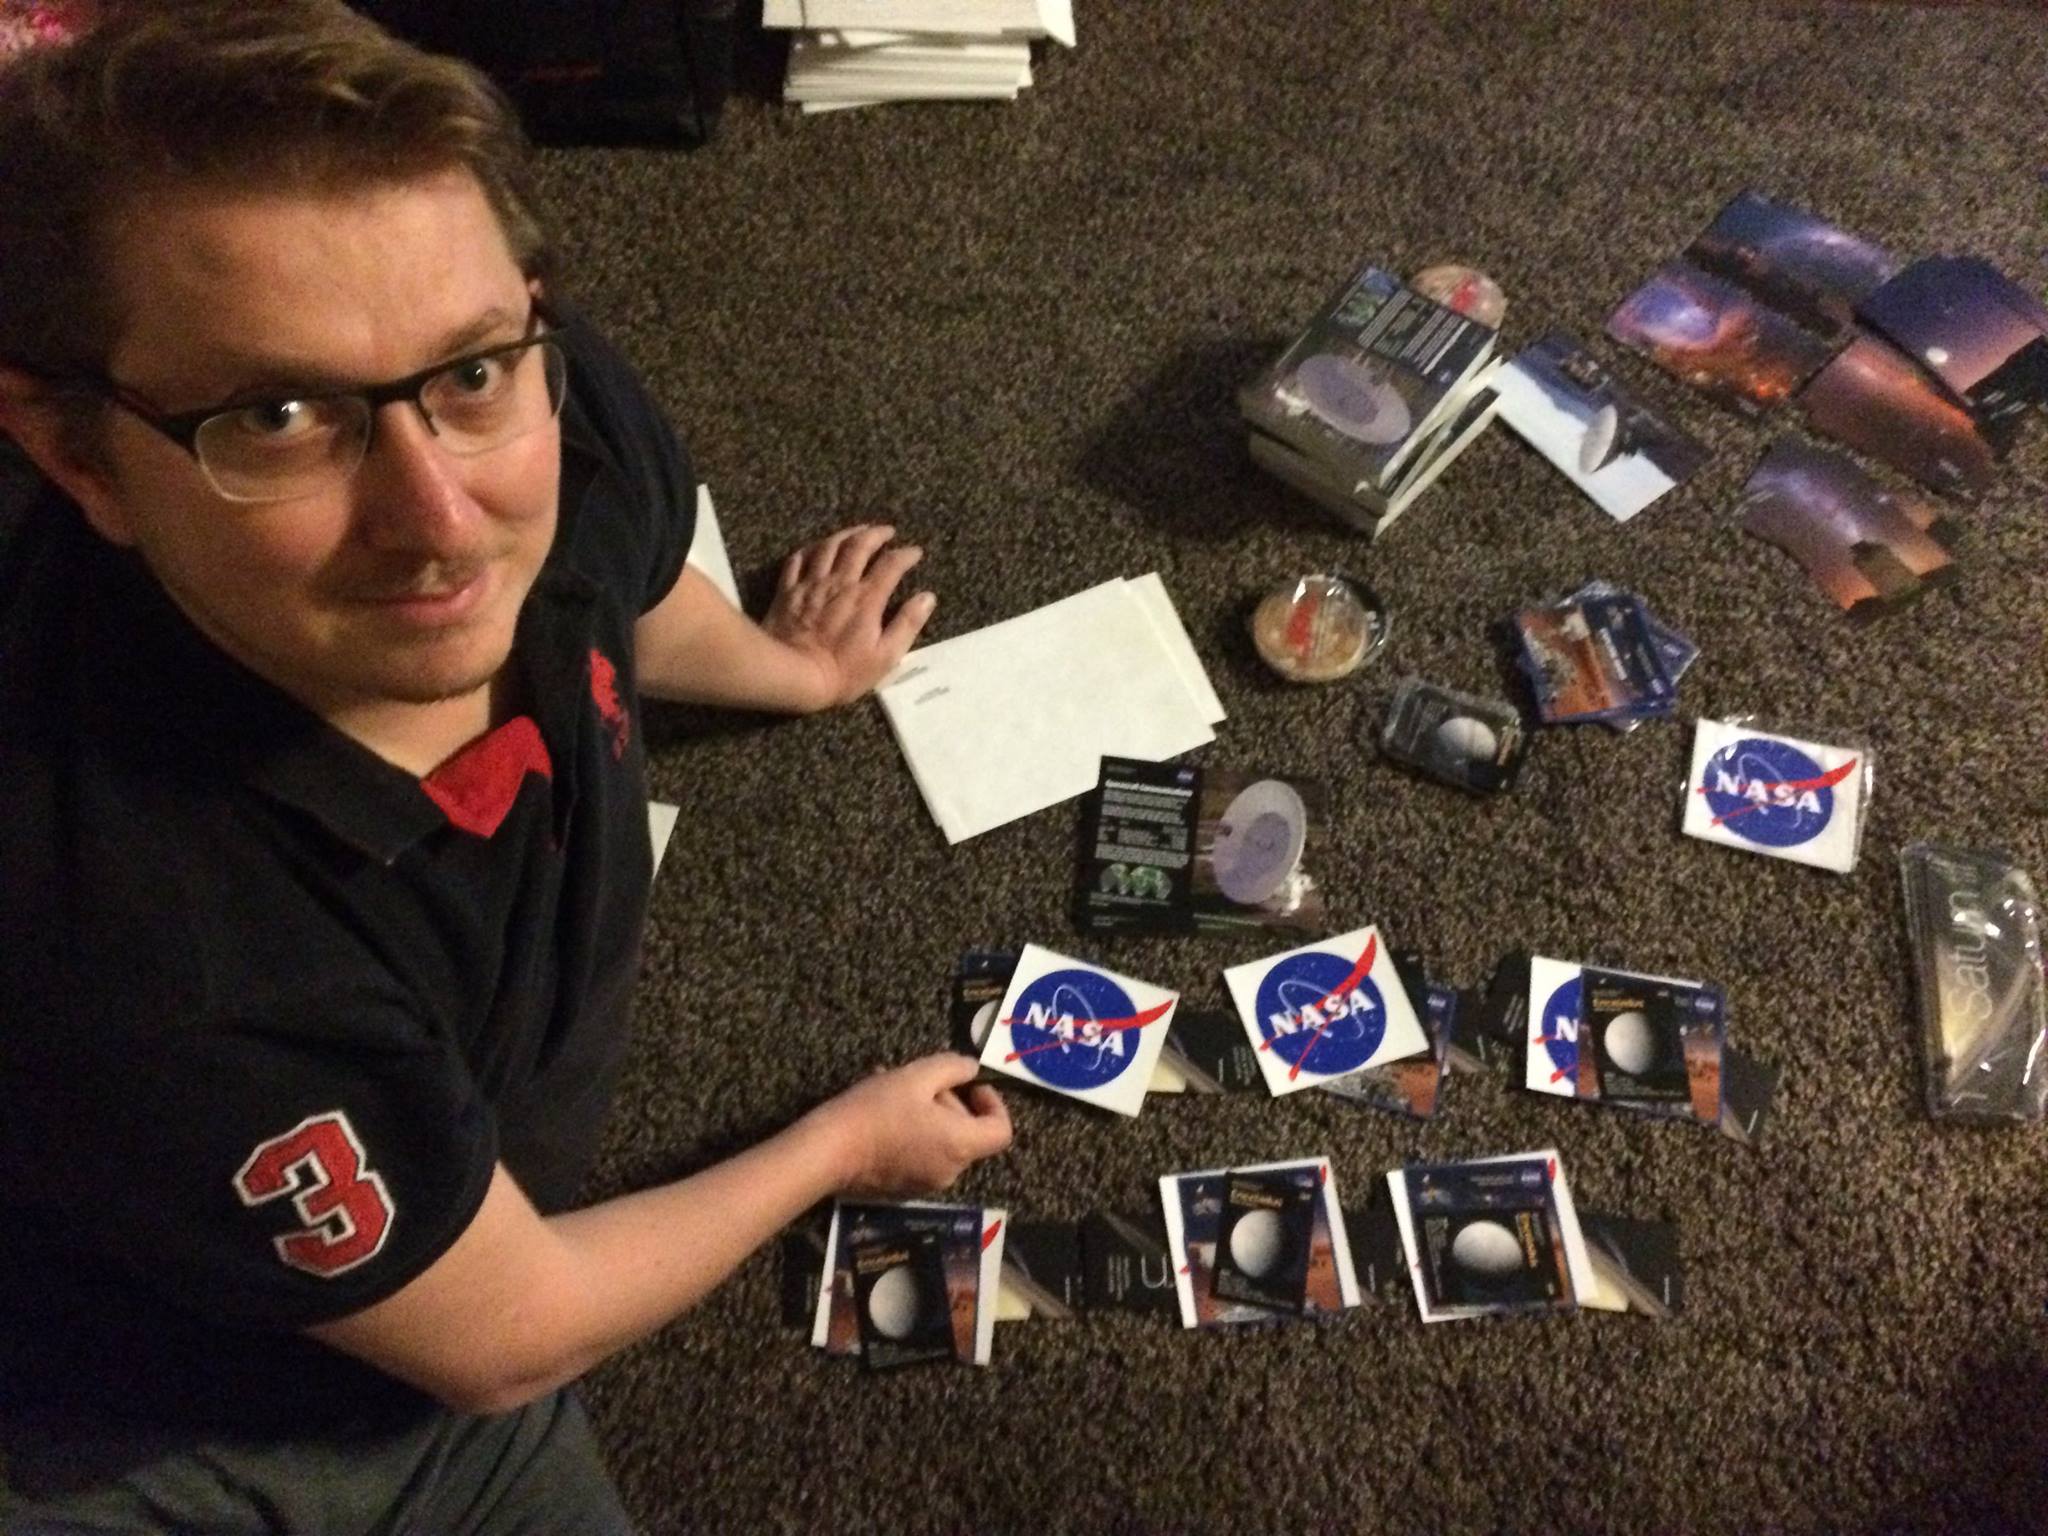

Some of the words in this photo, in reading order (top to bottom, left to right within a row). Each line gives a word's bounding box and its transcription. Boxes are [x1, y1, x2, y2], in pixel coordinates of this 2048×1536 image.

[1716, 770, 1821, 813] NASA
[1024, 1002, 1126, 1056] NASA
[1269, 987, 1376, 1039] NASA
[231, 1109, 396, 1278] 3
